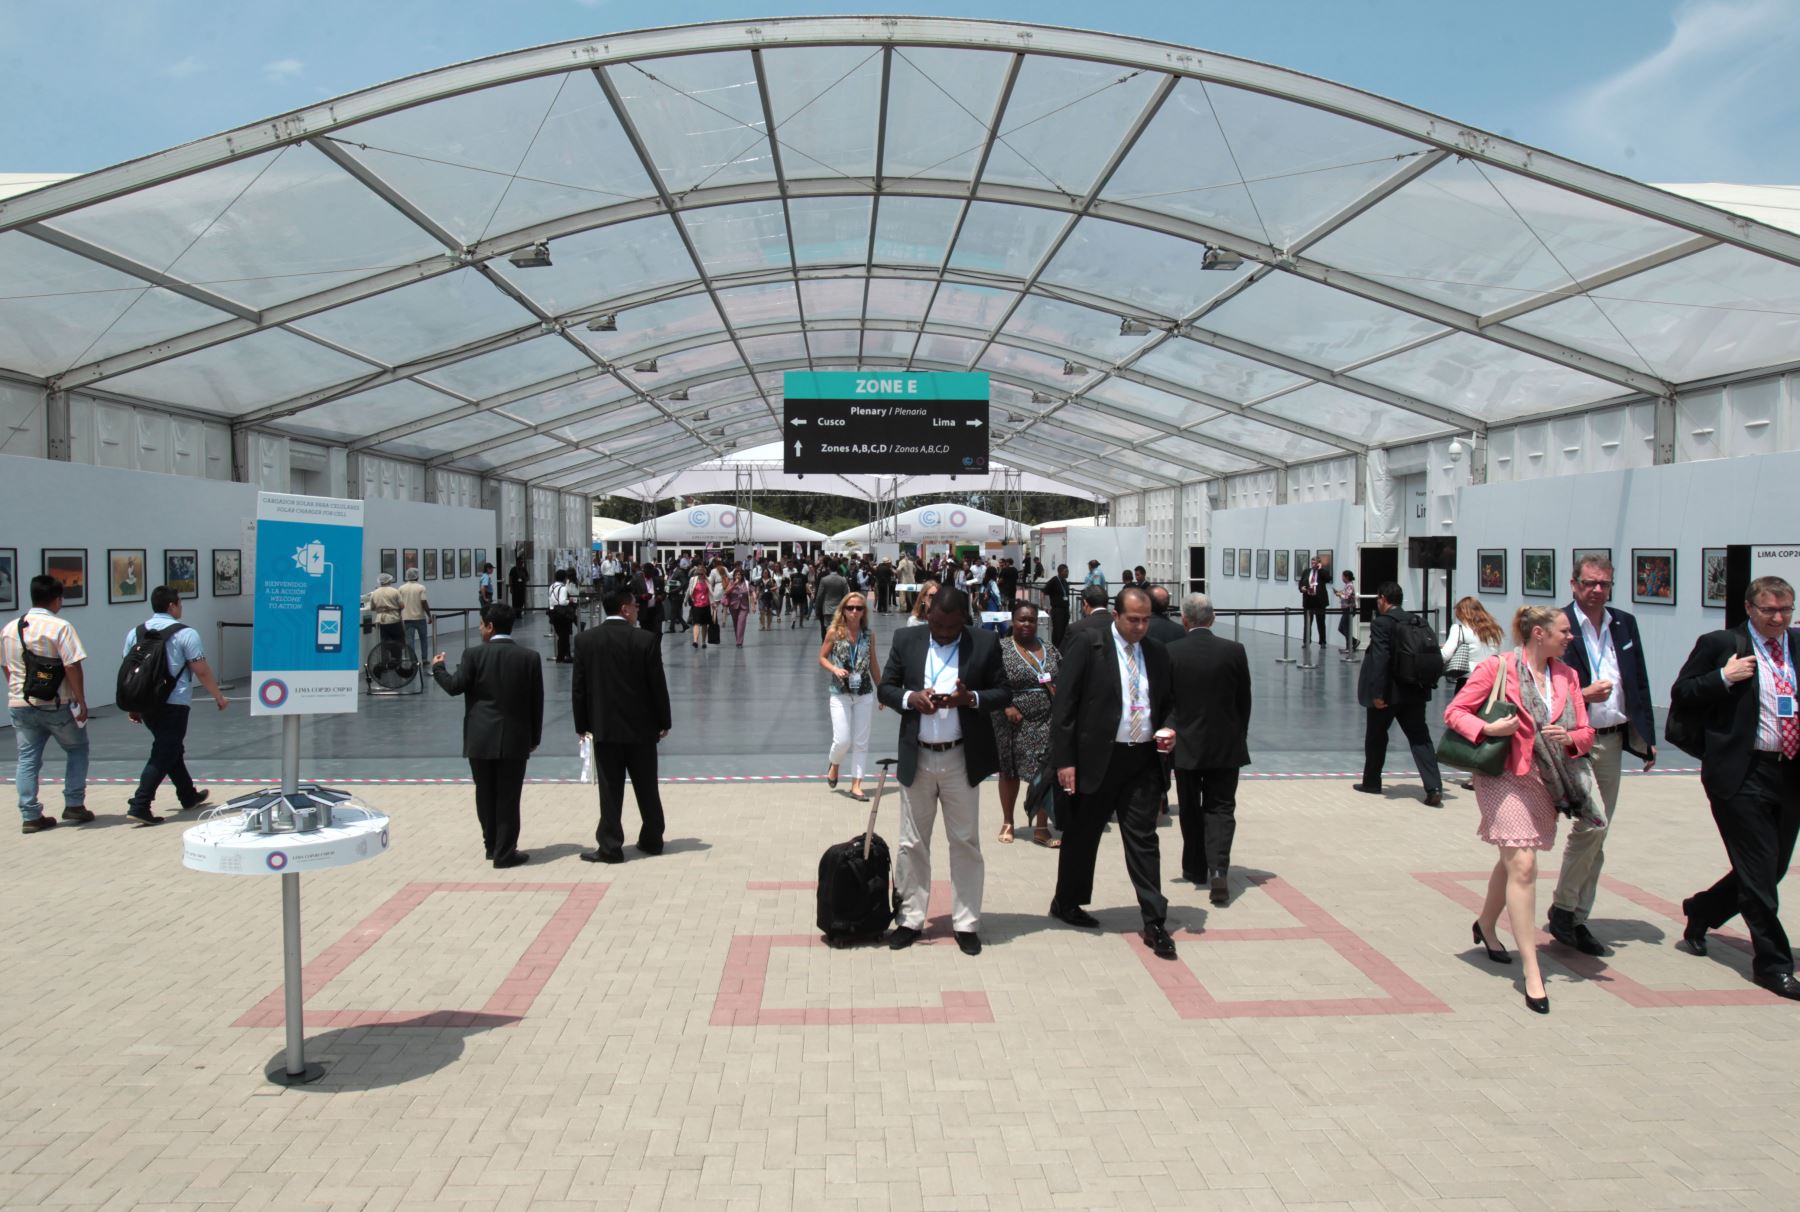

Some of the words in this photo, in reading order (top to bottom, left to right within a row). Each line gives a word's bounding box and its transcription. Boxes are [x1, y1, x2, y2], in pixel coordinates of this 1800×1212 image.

[855, 379, 903, 394] ZONE
[907, 379, 917, 394] E
[850, 406, 887, 417] Plenary
[894, 407, 927, 416] Plenaria
[817, 417, 846, 427] Cusco
[932, 417, 956, 427] Lima
[821, 444, 850, 453] Zones
[851, 444, 887, 454] A,B,C,D
[894, 444, 919, 453] Zonas
[919, 444, 950, 455] A,B,C,D
[1416, 503, 1426, 518] Li
